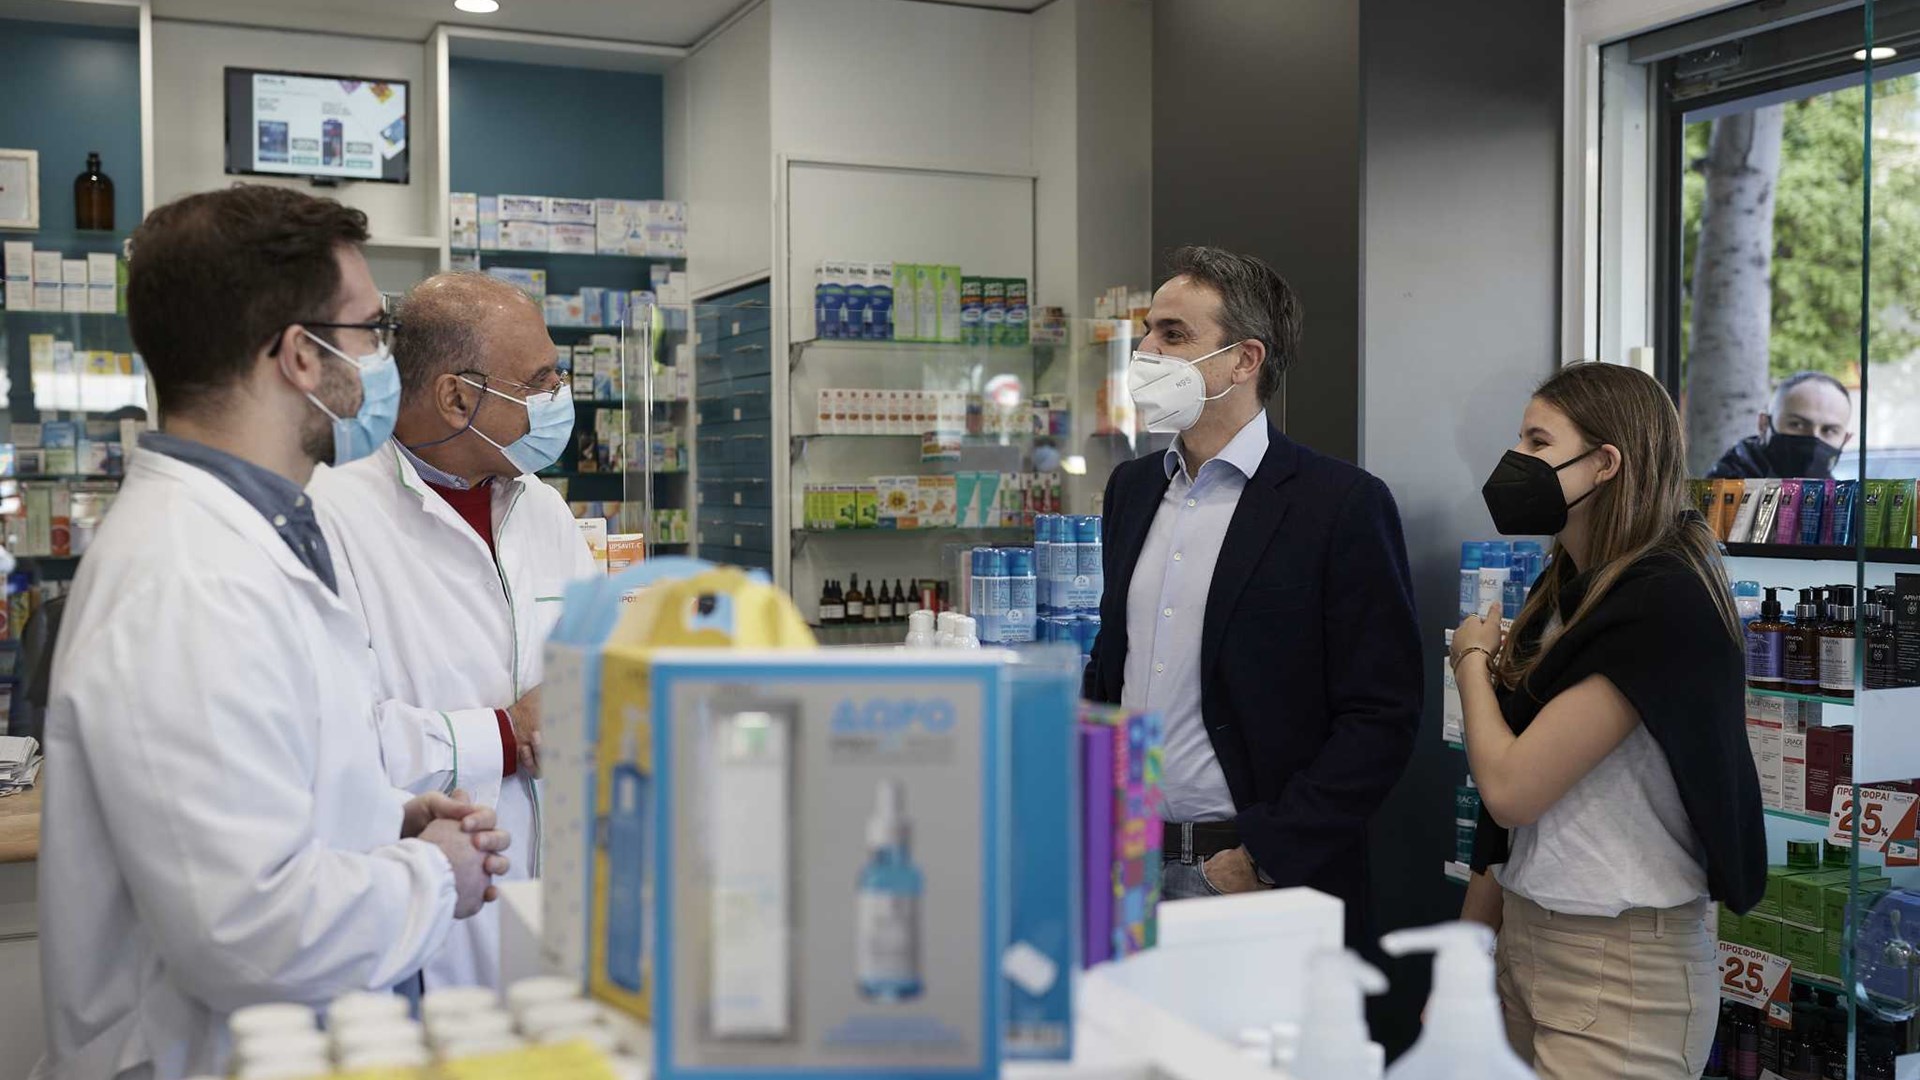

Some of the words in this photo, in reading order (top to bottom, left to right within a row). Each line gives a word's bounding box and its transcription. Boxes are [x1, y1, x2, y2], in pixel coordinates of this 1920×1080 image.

[1176, 376, 1192, 388] N95
[1836, 787, 1891, 802] ΠΡΟΦΟΡΑ!
[1719, 943, 1770, 963] ΠΡΟΣΦΟΡΑ!
